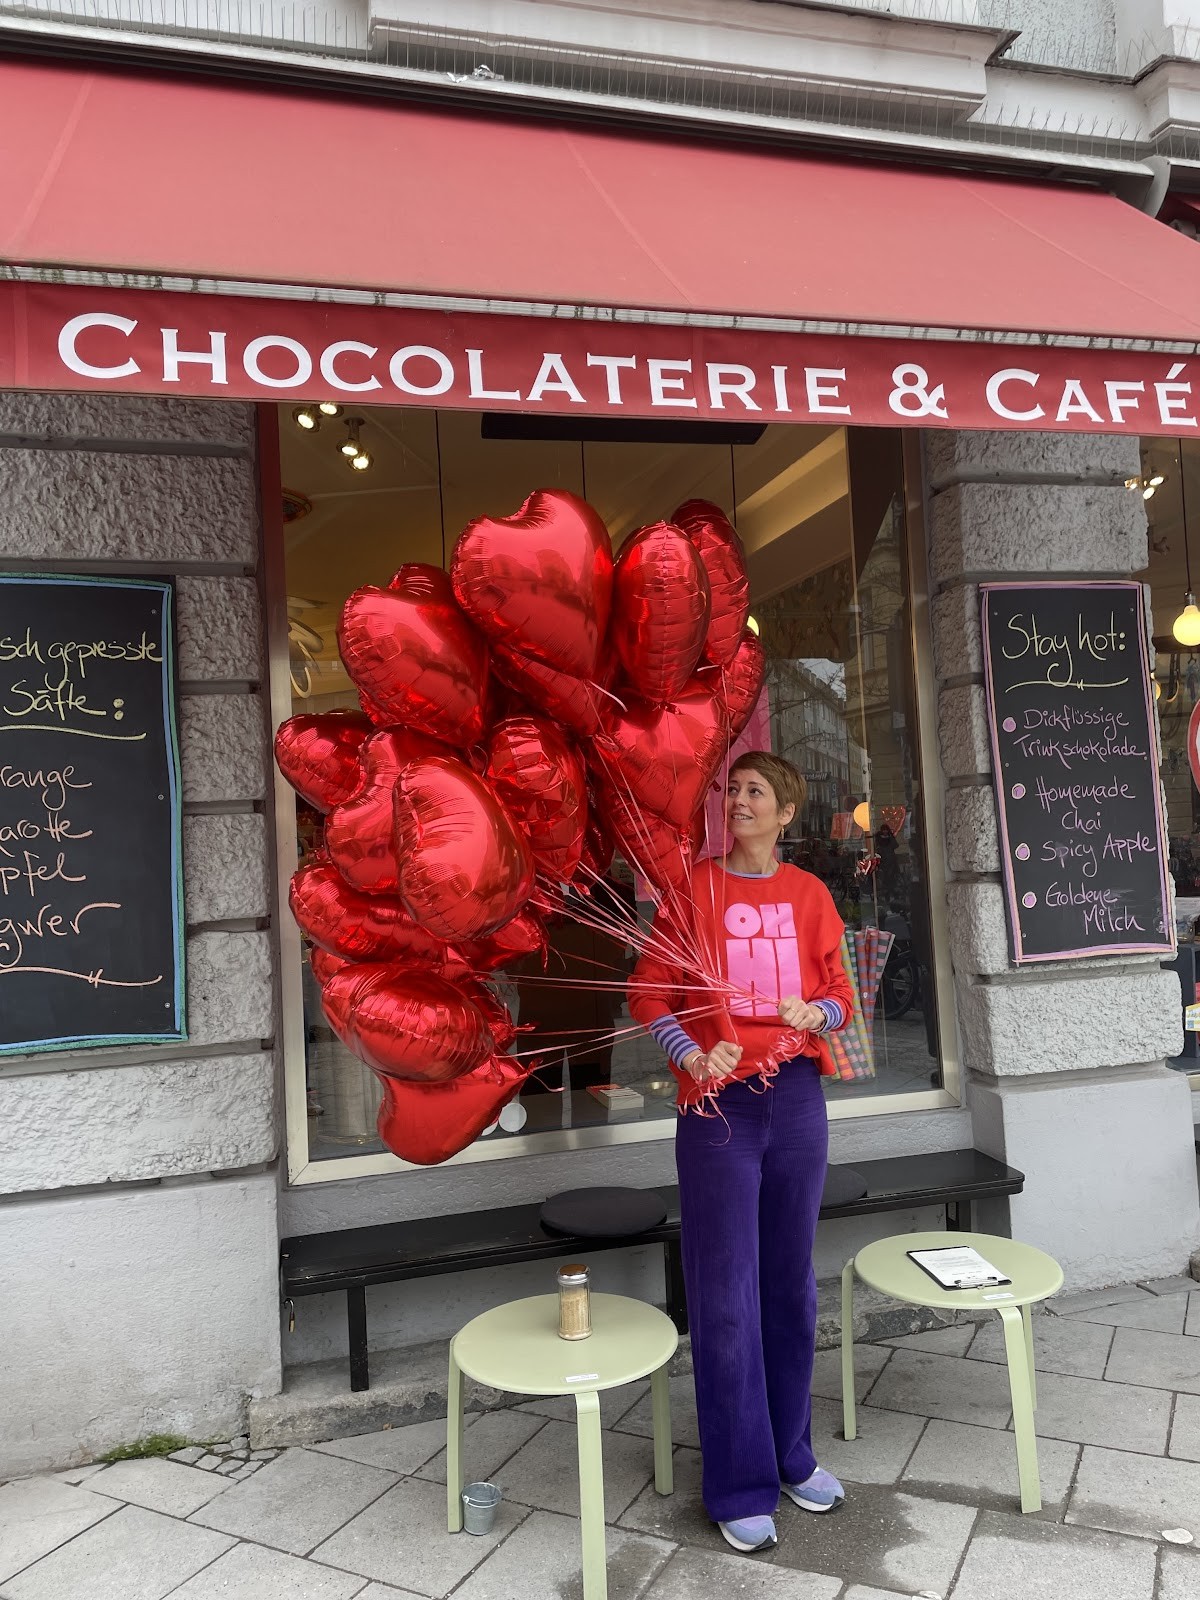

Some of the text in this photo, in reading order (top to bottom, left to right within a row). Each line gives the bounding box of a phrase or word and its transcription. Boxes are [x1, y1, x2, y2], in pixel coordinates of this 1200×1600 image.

[58, 312, 1198, 428] CHOCOLATERIE & CAFÉ
[45, 632, 162, 690] gepresste
[1002, 611, 1126, 687] Stay hot:
[1023, 704, 1130, 741] Dickflüssige
[1035, 776, 1136, 813] Homemade
[0, 812, 93, 857] arotte
[1061, 809, 1102, 834] Chai
[1102, 831, 1156, 863] Apple
[1045, 882, 1118, 909] Goldene
[723, 902, 797, 938] OH
[1083, 904, 1146, 935] Milch
[725, 937, 802, 1017] HI
